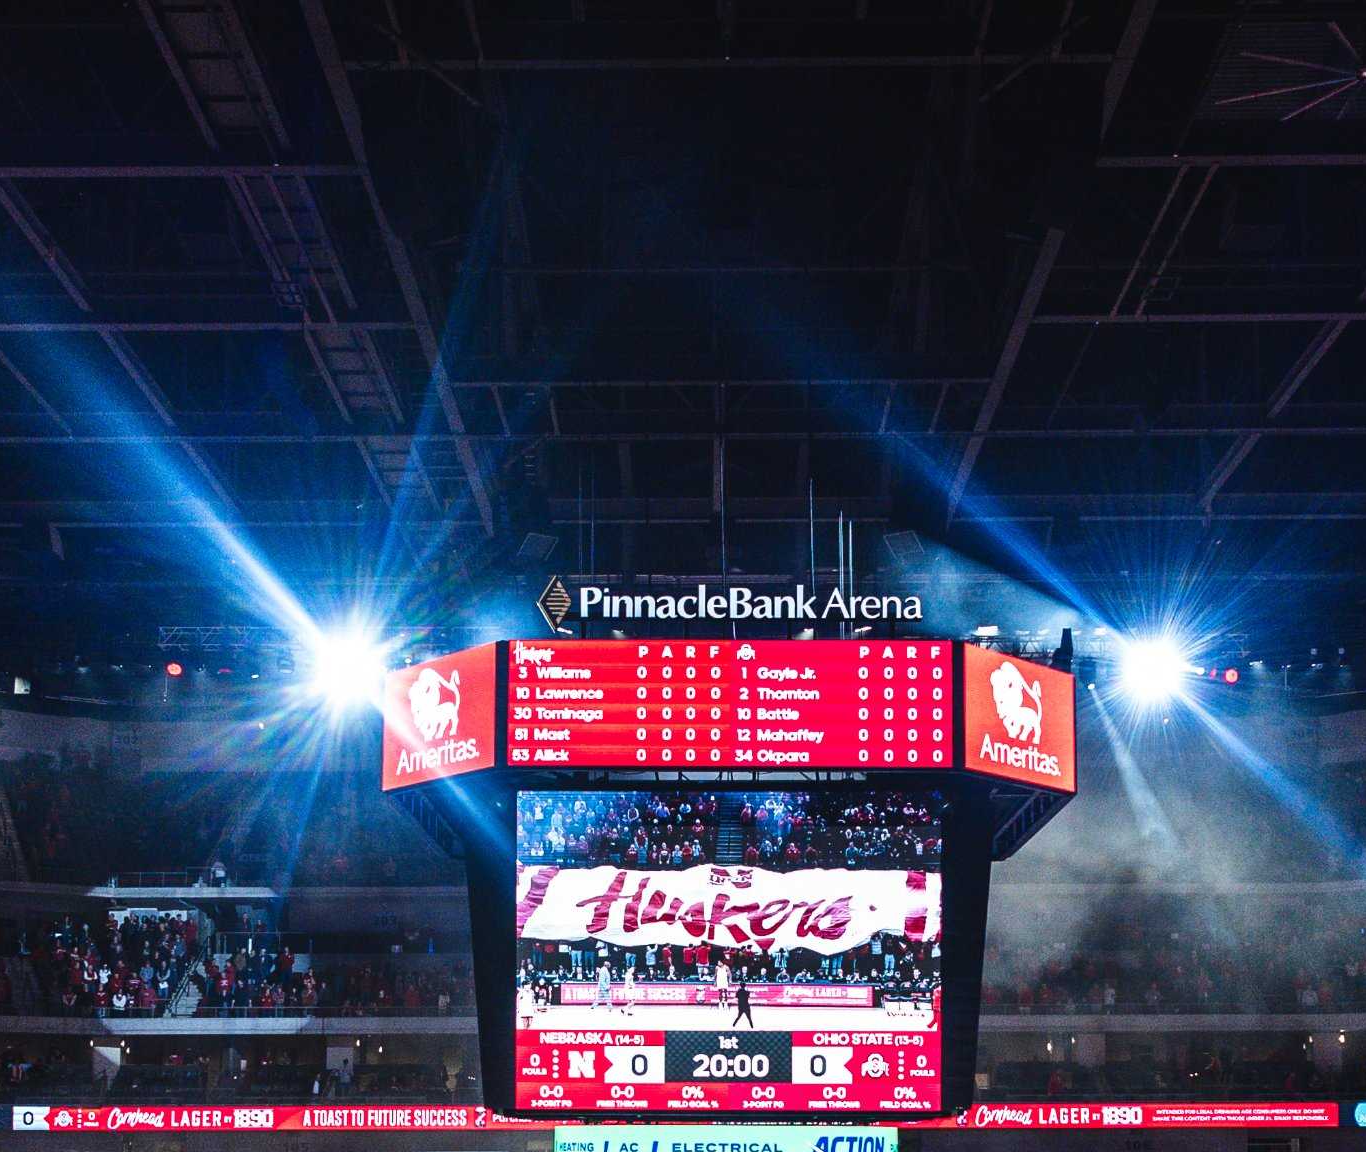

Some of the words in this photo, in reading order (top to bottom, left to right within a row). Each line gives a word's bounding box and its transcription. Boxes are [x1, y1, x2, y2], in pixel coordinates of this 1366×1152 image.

[822, 588, 923, 619] Arena
[639, 646, 648, 657] P
[662, 646, 673, 657] A
[686, 646, 695, 658] R
[710, 646, 719, 658] F
[860, 646, 869, 658] P
[883, 647, 893, 658] A
[907, 646, 916, 658] R
[931, 646, 940, 659] F
[519, 667, 527, 679] 3
[536, 667, 591, 678] Williams
[742, 667, 747, 679] 1
[757, 667, 798, 681] Gayle
[800, 667, 816, 679] Jr.
[516, 687, 530, 699] 10
[536, 687, 603, 699] Lawrence
[740, 687, 748, 700] 2
[757, 688, 819, 700] Thornton
[514, 707, 532, 719] 30
[536, 707, 603, 722] Tominaga
[737, 708, 751, 720] 10
[757, 708, 799, 720] Battle
[515, 728, 528, 740] 51
[534, 728, 570, 740] Mast
[737, 729, 750, 741] 12
[757, 729, 824, 743] Mahaffey
[396, 737, 480, 777] Ameritas.
[512, 749, 529, 761] 53
[534, 749, 569, 761] Allick
[735, 750, 753, 762] 34
[757, 750, 809, 764] Okpara
[979, 739, 1062, 778] Ameritas.
[576, 870, 878, 950] Huskers
[540, 1032, 613, 1044] NEBRASKA
[719, 1036, 738, 1049] 1st
[813, 1033, 849, 1045] OHIO
[852, 1033, 892, 1044] STATE
[568, 1051, 595, 1078] N
[632, 1054, 648, 1075] 0
[693, 1054, 769, 1077] 20:00
[810, 1055, 826, 1077] 0
[540, 1085, 563, 1097] 0-0
[682, 1086, 704, 1098] 0%
[23, 1112, 34, 1125] 0
[107, 1107, 164, 1129] Cornhead
[171, 1111, 221, 1126] LAGER
[234, 1109, 273, 1128] 1890
[303, 1110, 311, 1126] A
[314, 1110, 349, 1126] TOAST
[351, 1110, 364, 1126] TO
[368, 1110, 411, 1126] FUTURE
[414, 1109, 467, 1126] SUCCESS
[975, 1105, 1032, 1127] Cornhead
[1039, 1108, 1089, 1124] LAGER
[1102, 1107, 1142, 1124] 1890
[620, 1143, 638, 1152] AC
[673, 1143, 783, 1152] ELECTRICAL
